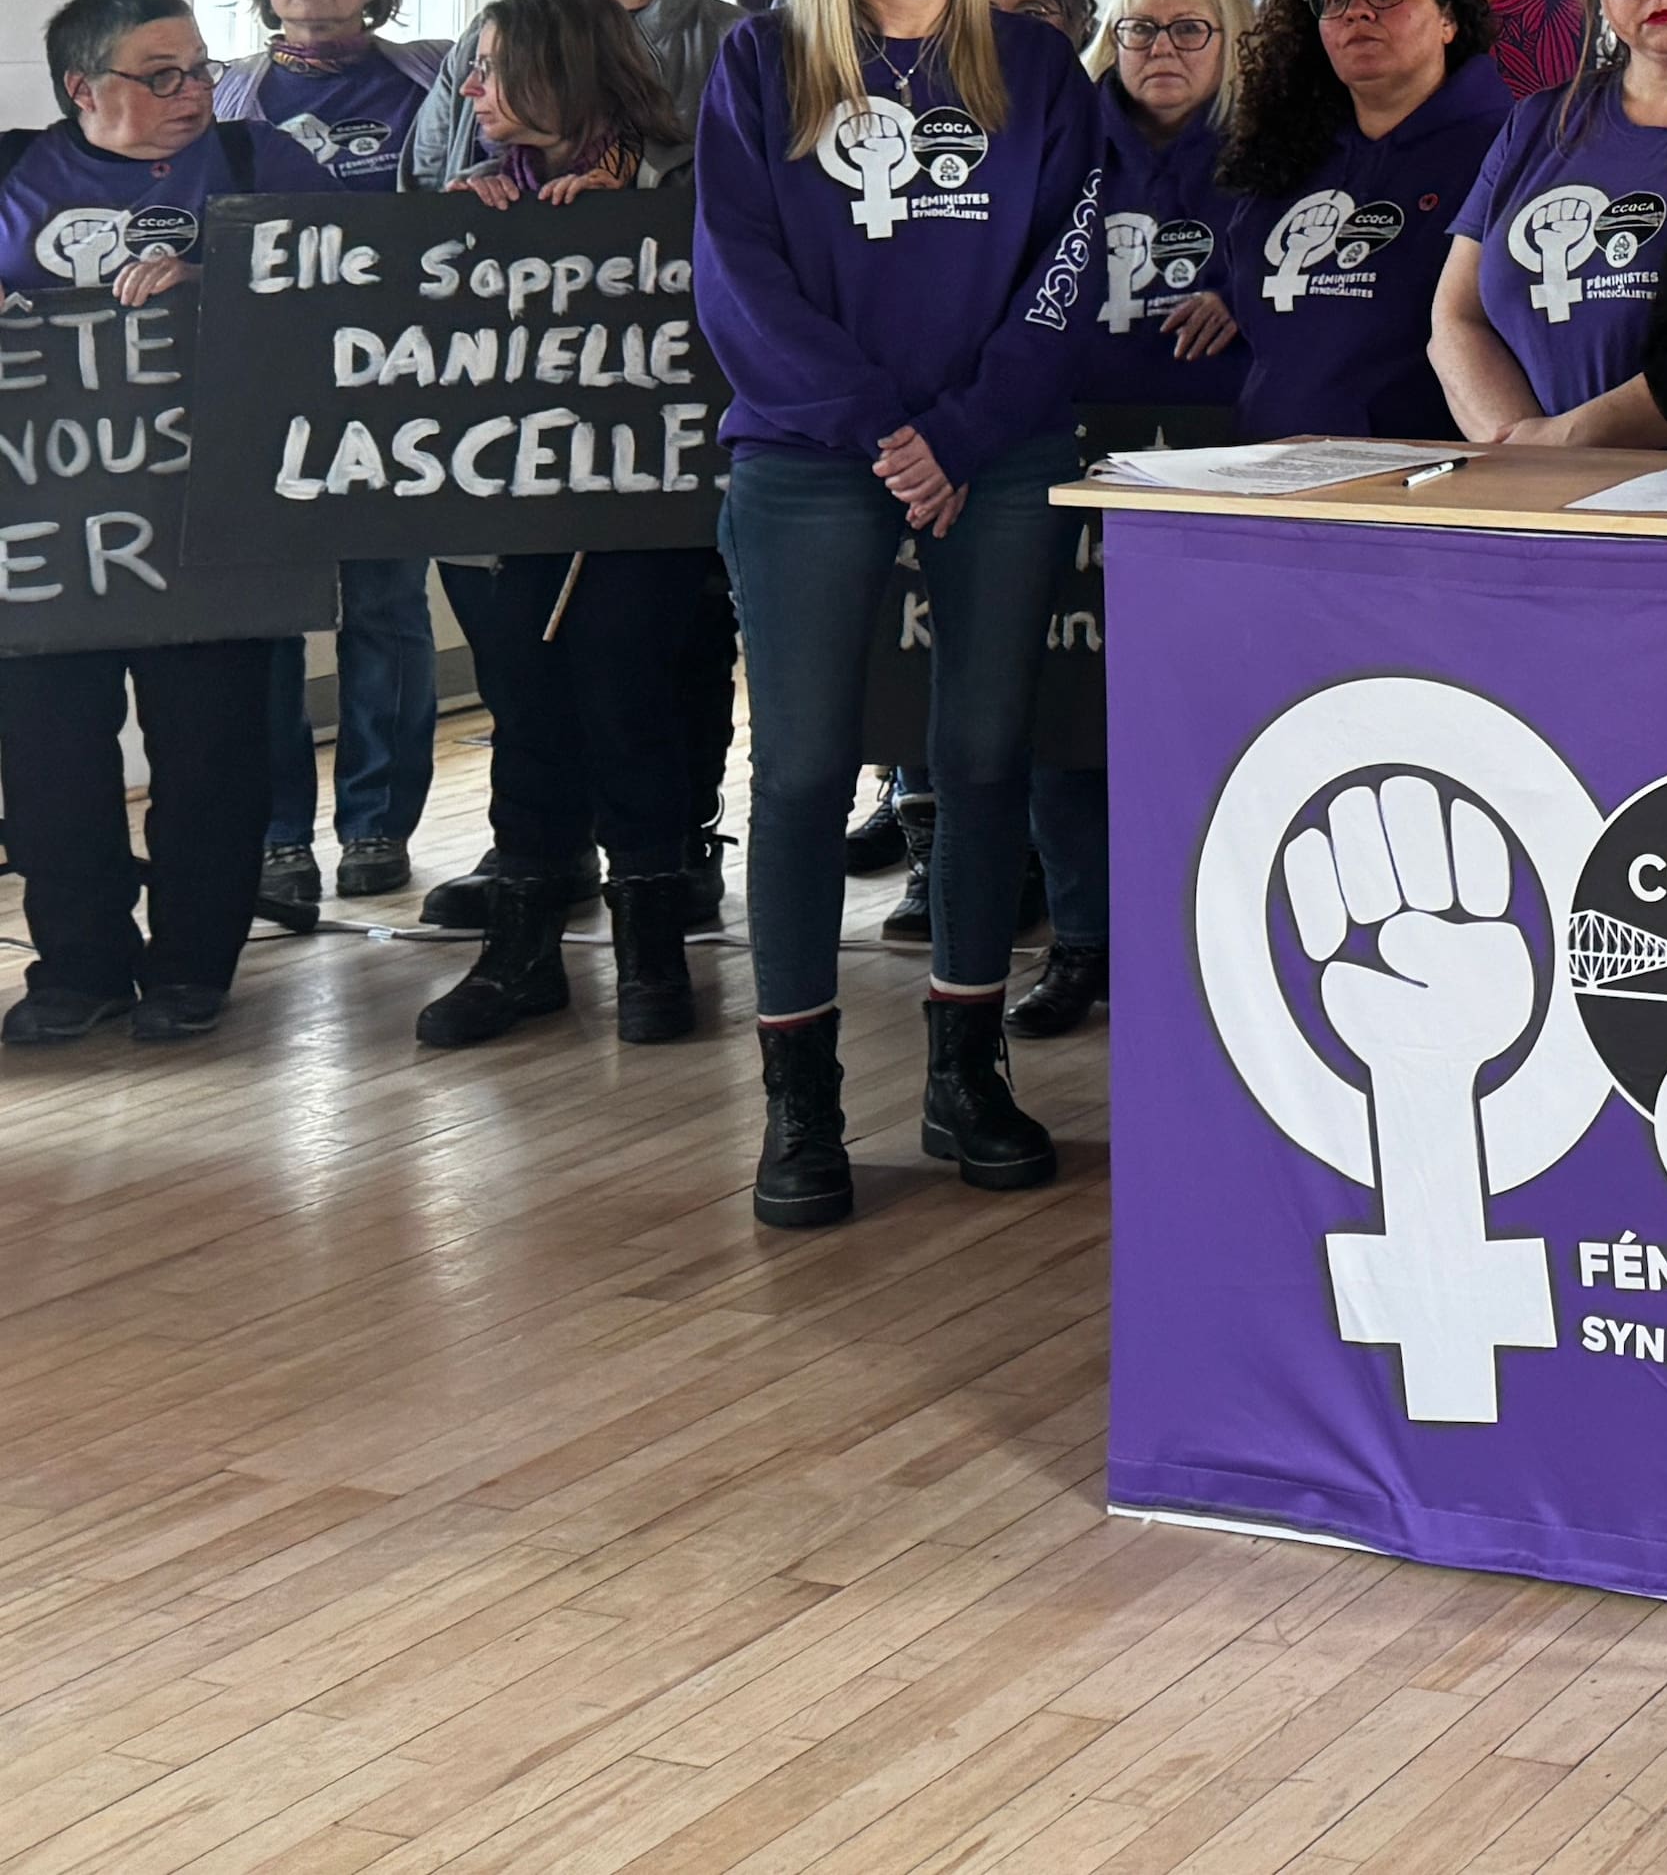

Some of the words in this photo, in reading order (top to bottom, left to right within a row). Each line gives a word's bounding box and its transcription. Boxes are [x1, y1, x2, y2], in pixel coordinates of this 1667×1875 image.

[922, 123, 974, 135] CCQCA
[911, 193, 990, 209] FÉMINISTES
[1611, 202, 1656, 215] CCQCA
[138, 217, 187, 228] CCQCA
[1354, 214, 1395, 225] CCQCA
[250, 220, 380, 293] Elle
[1311, 272, 1377, 286] FÉMINISTES
[1586, 271, 1660, 291] FÉMINISTES
[334, 321, 694, 388] DANIELLE
[275, 403, 730, 501] LASCELLE
